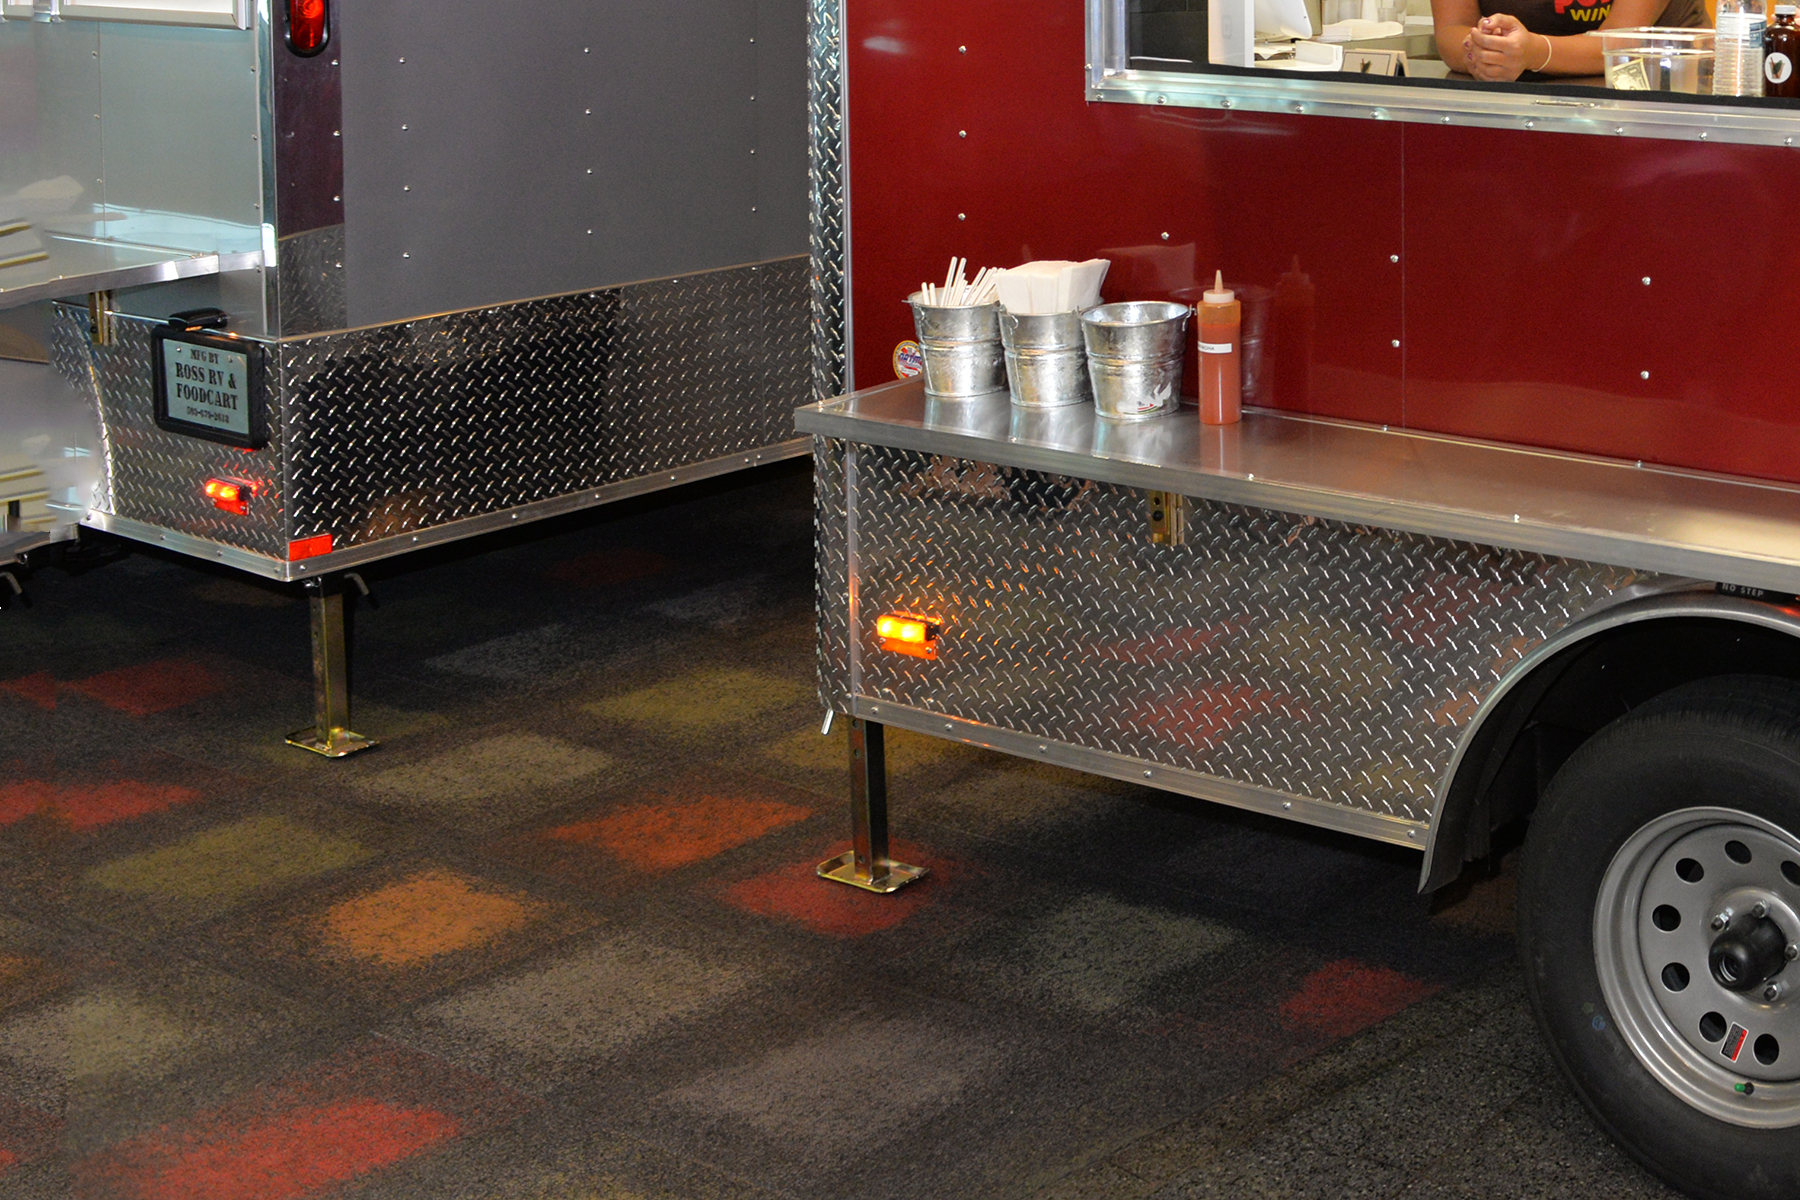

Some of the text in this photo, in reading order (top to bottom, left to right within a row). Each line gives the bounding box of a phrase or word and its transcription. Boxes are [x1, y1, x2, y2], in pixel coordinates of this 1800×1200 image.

[1570, 3, 1611, 22] WIN
[191, 349, 220, 365] MFG BY
[176, 362, 237, 390] ROSS RV &
[176, 383, 239, 410] FOODCART
[1722, 582, 1764, 597] NO STEP
